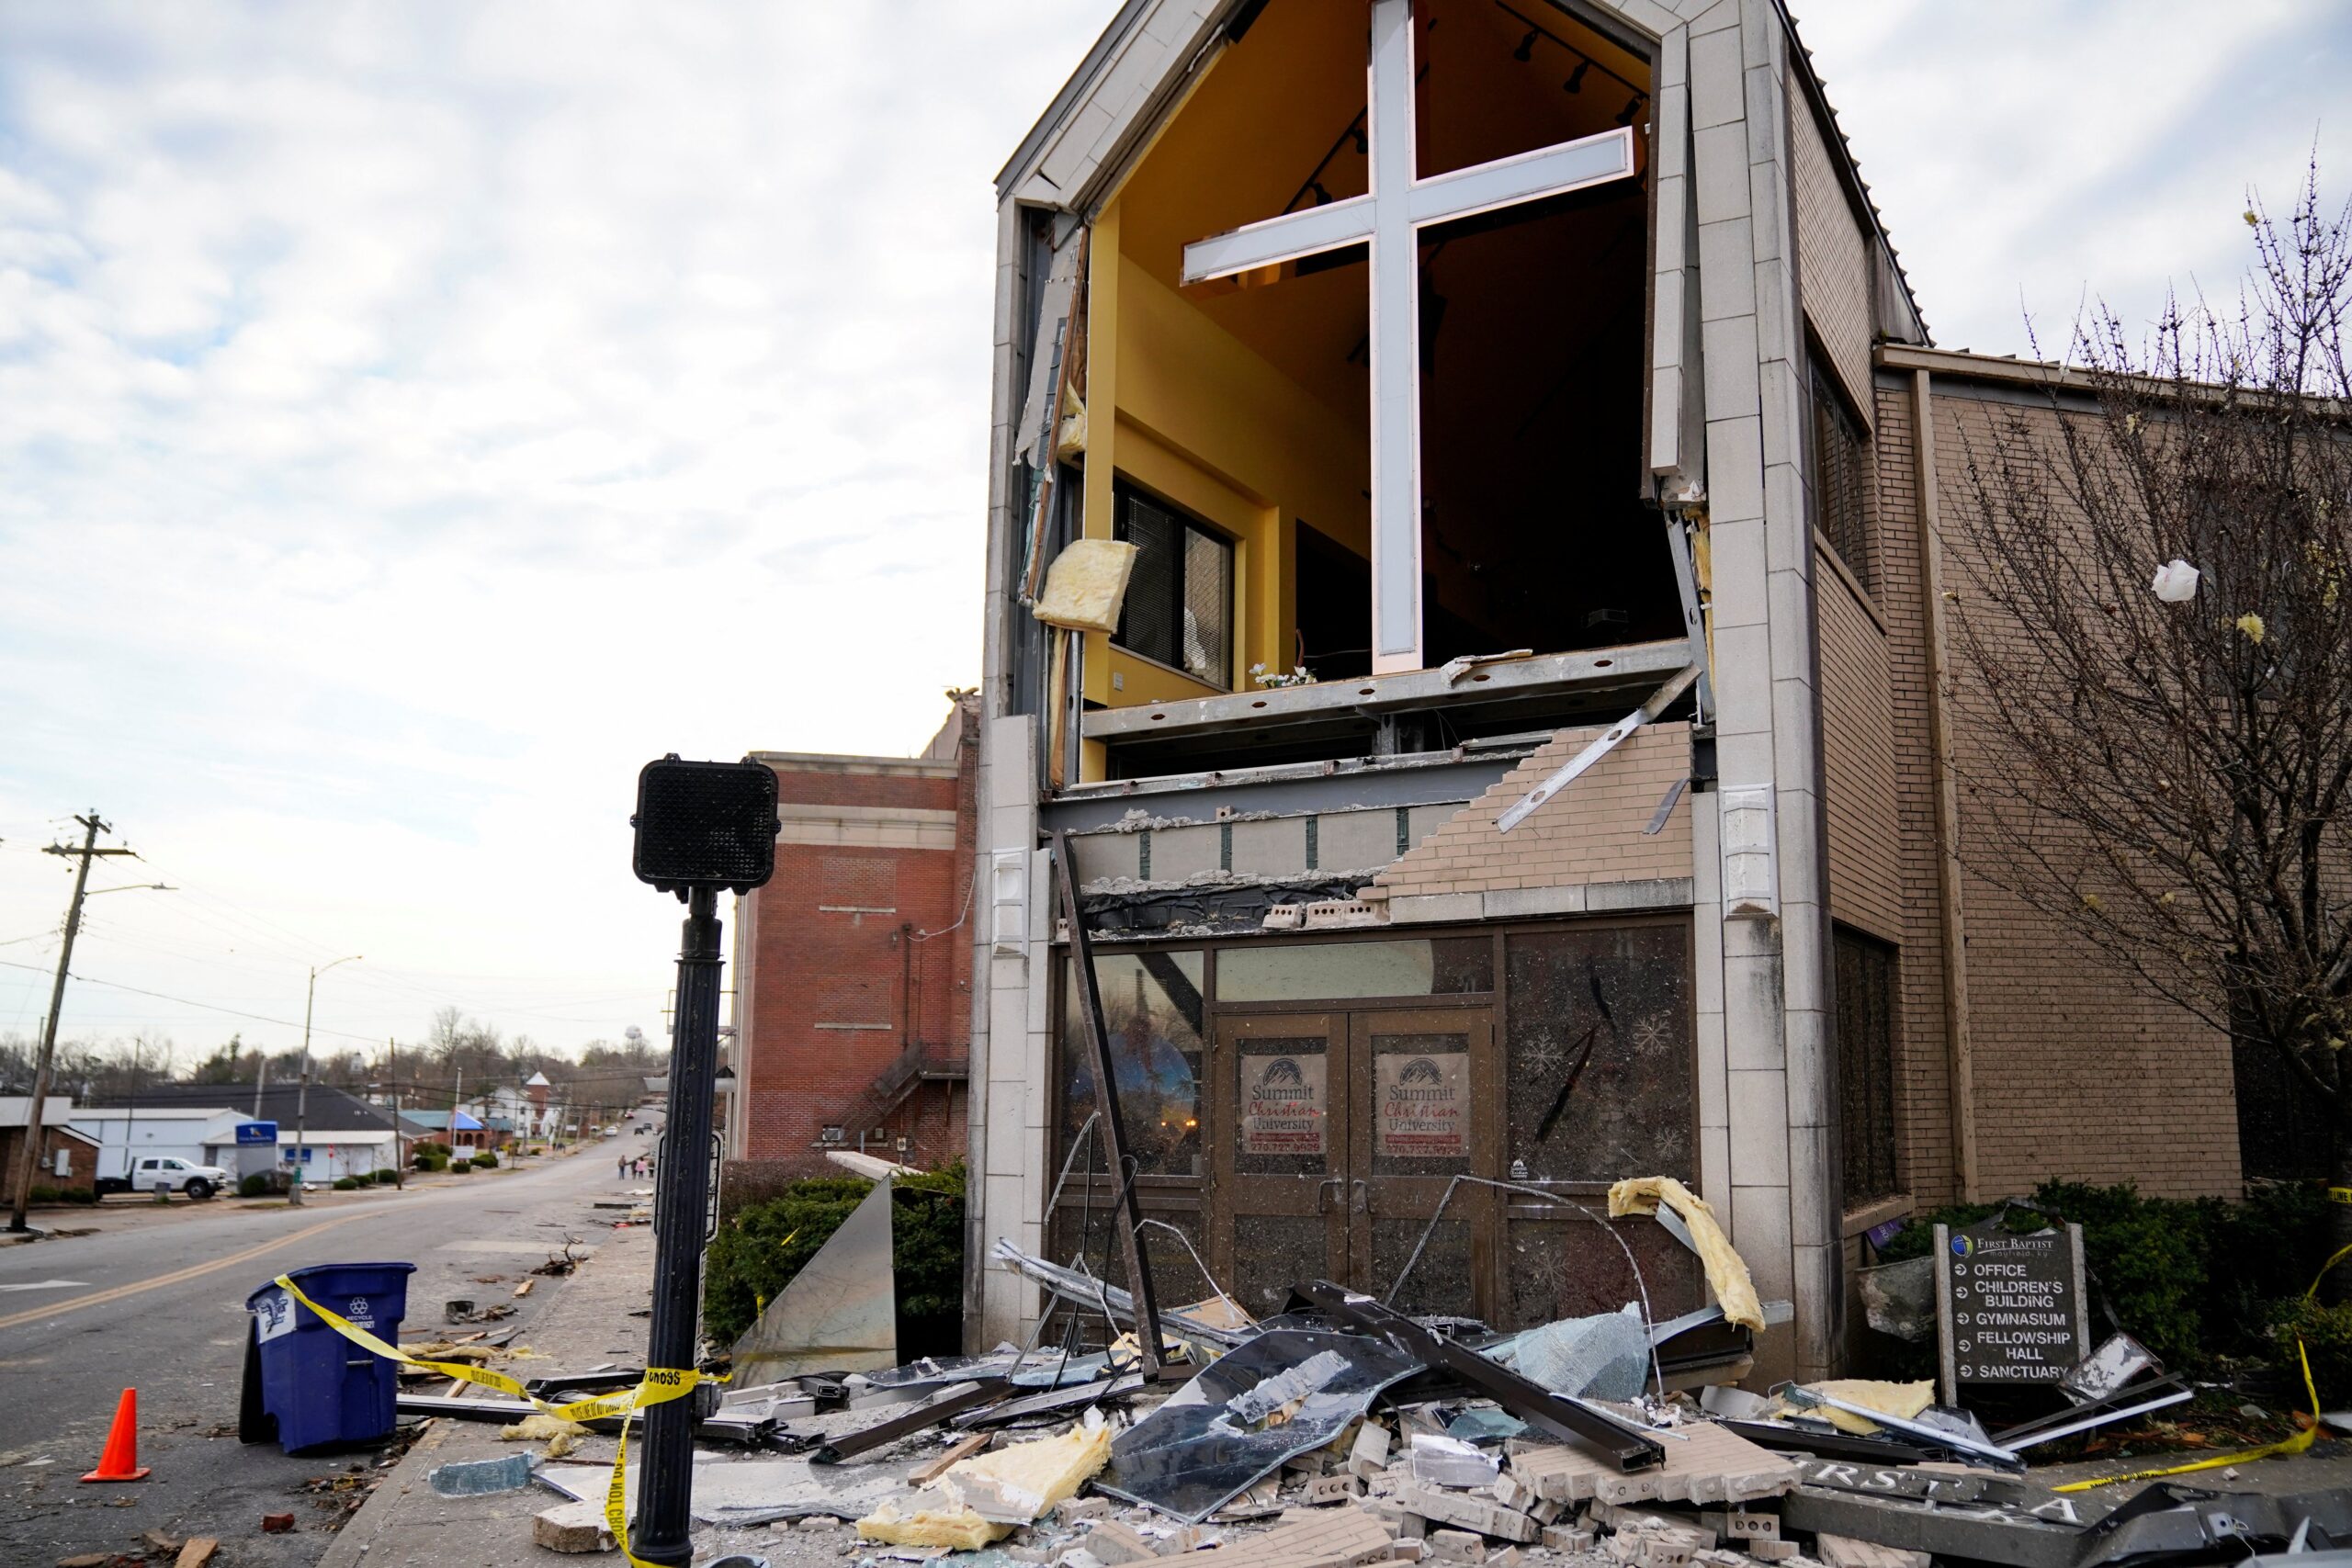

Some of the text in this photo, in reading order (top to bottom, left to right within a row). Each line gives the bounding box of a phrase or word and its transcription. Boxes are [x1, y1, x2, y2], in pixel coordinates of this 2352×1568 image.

[1252, 1085, 1315, 1100] Summit
[1389, 1085, 1456, 1100] Summit
[1249, 1101, 1320, 1117] Christian
[1385, 1101, 1460, 1118] Christian
[1253, 1118, 1315, 1133] University
[1389, 1118, 1455, 1134] University
[1977, 1237, 2054, 1249] FIRST BAPTIST
[1974, 1264, 2027, 1277] OFFICE
[1975, 1280, 2064, 1294] CHILDREN'S
[1985, 1295, 2054, 1308] BUILDING
[1976, 1313, 2066, 1325] GYMNASIUM
[1977, 1332, 2071, 1345] FELLOWSHIP
[2006, 1348, 2044, 1360] HALL
[1979, 1365, 2069, 1379] SANCTUARY
